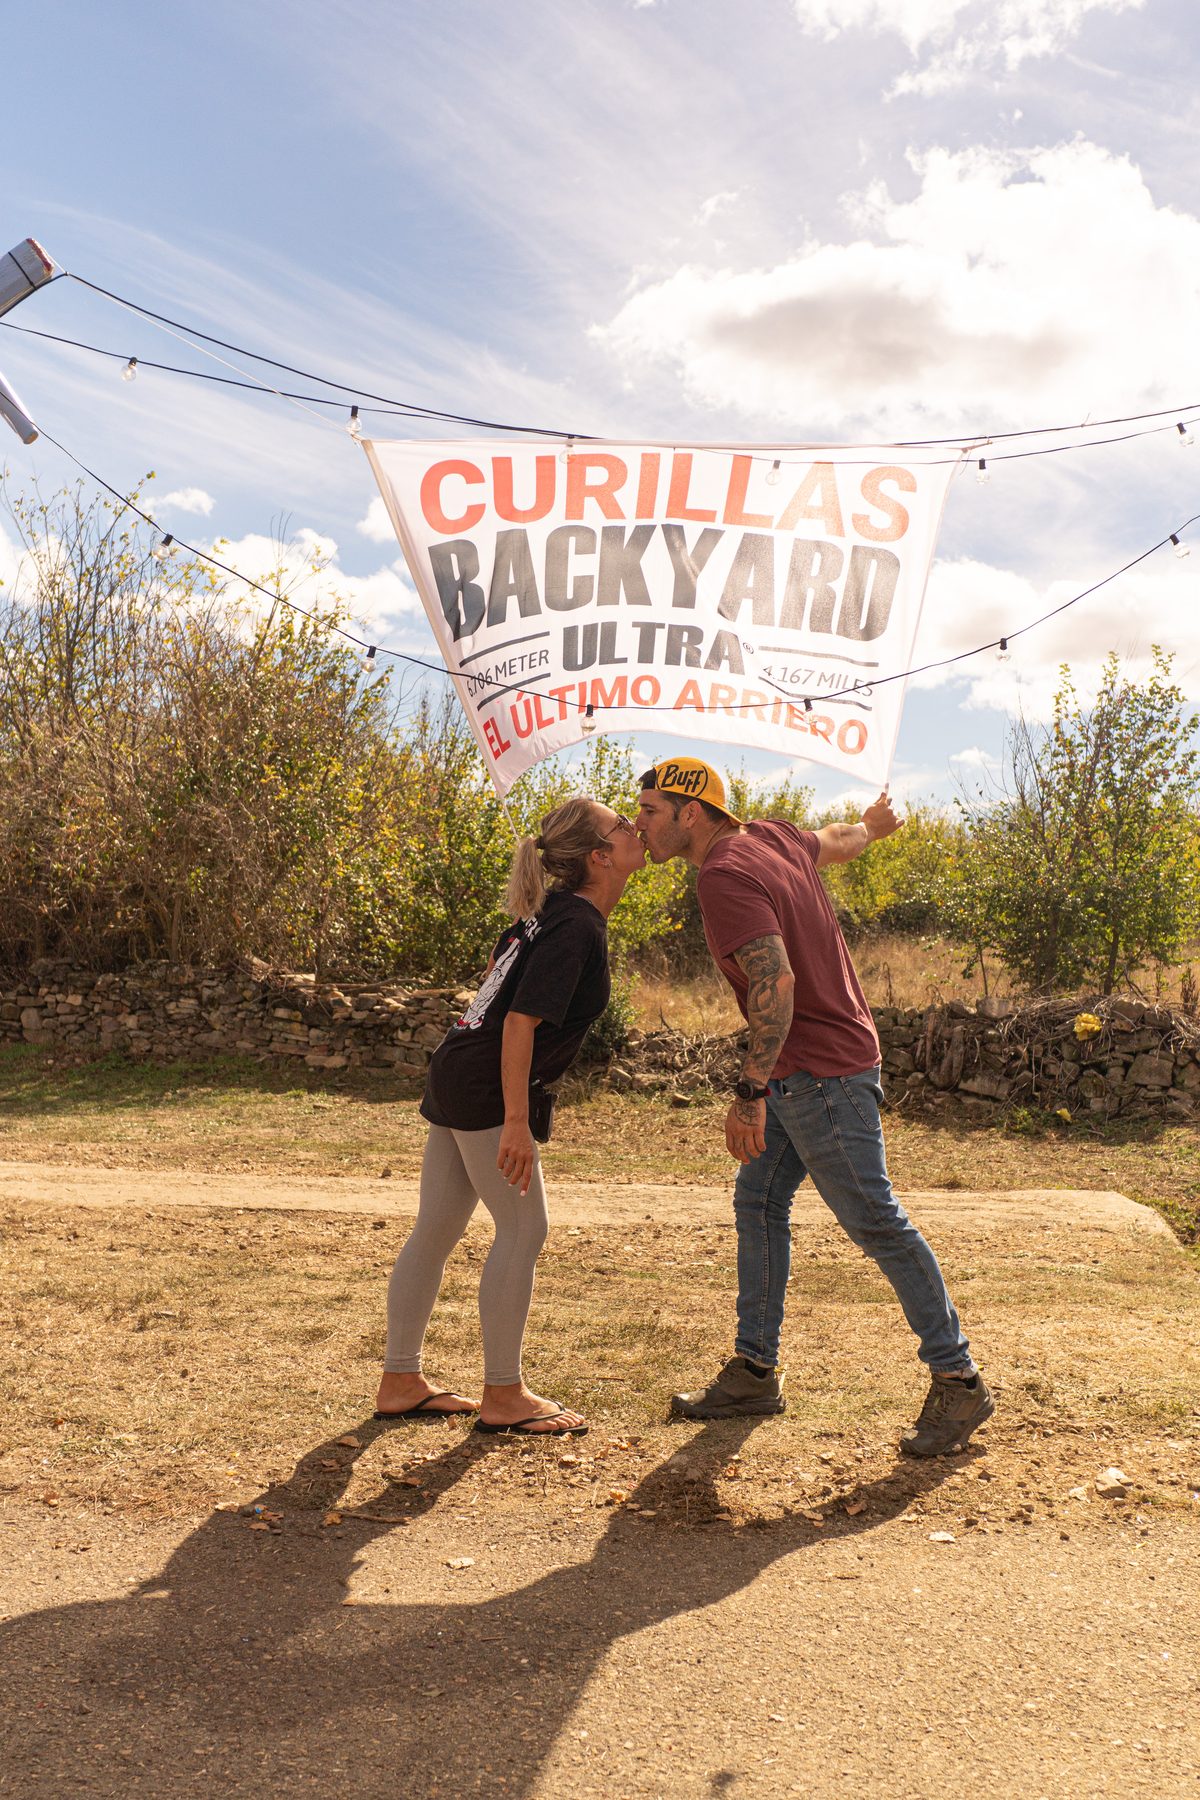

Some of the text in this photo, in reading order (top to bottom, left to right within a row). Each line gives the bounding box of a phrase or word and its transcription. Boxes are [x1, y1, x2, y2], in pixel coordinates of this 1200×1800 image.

[420, 453, 917, 542] CURILLAS
[428, 524, 901, 642] BACKYARD
[495, 649, 550, 681] METER
[817, 671, 874, 697] MILES
[483, 674, 868, 760] EL ÚLTIMO ARRIERO
